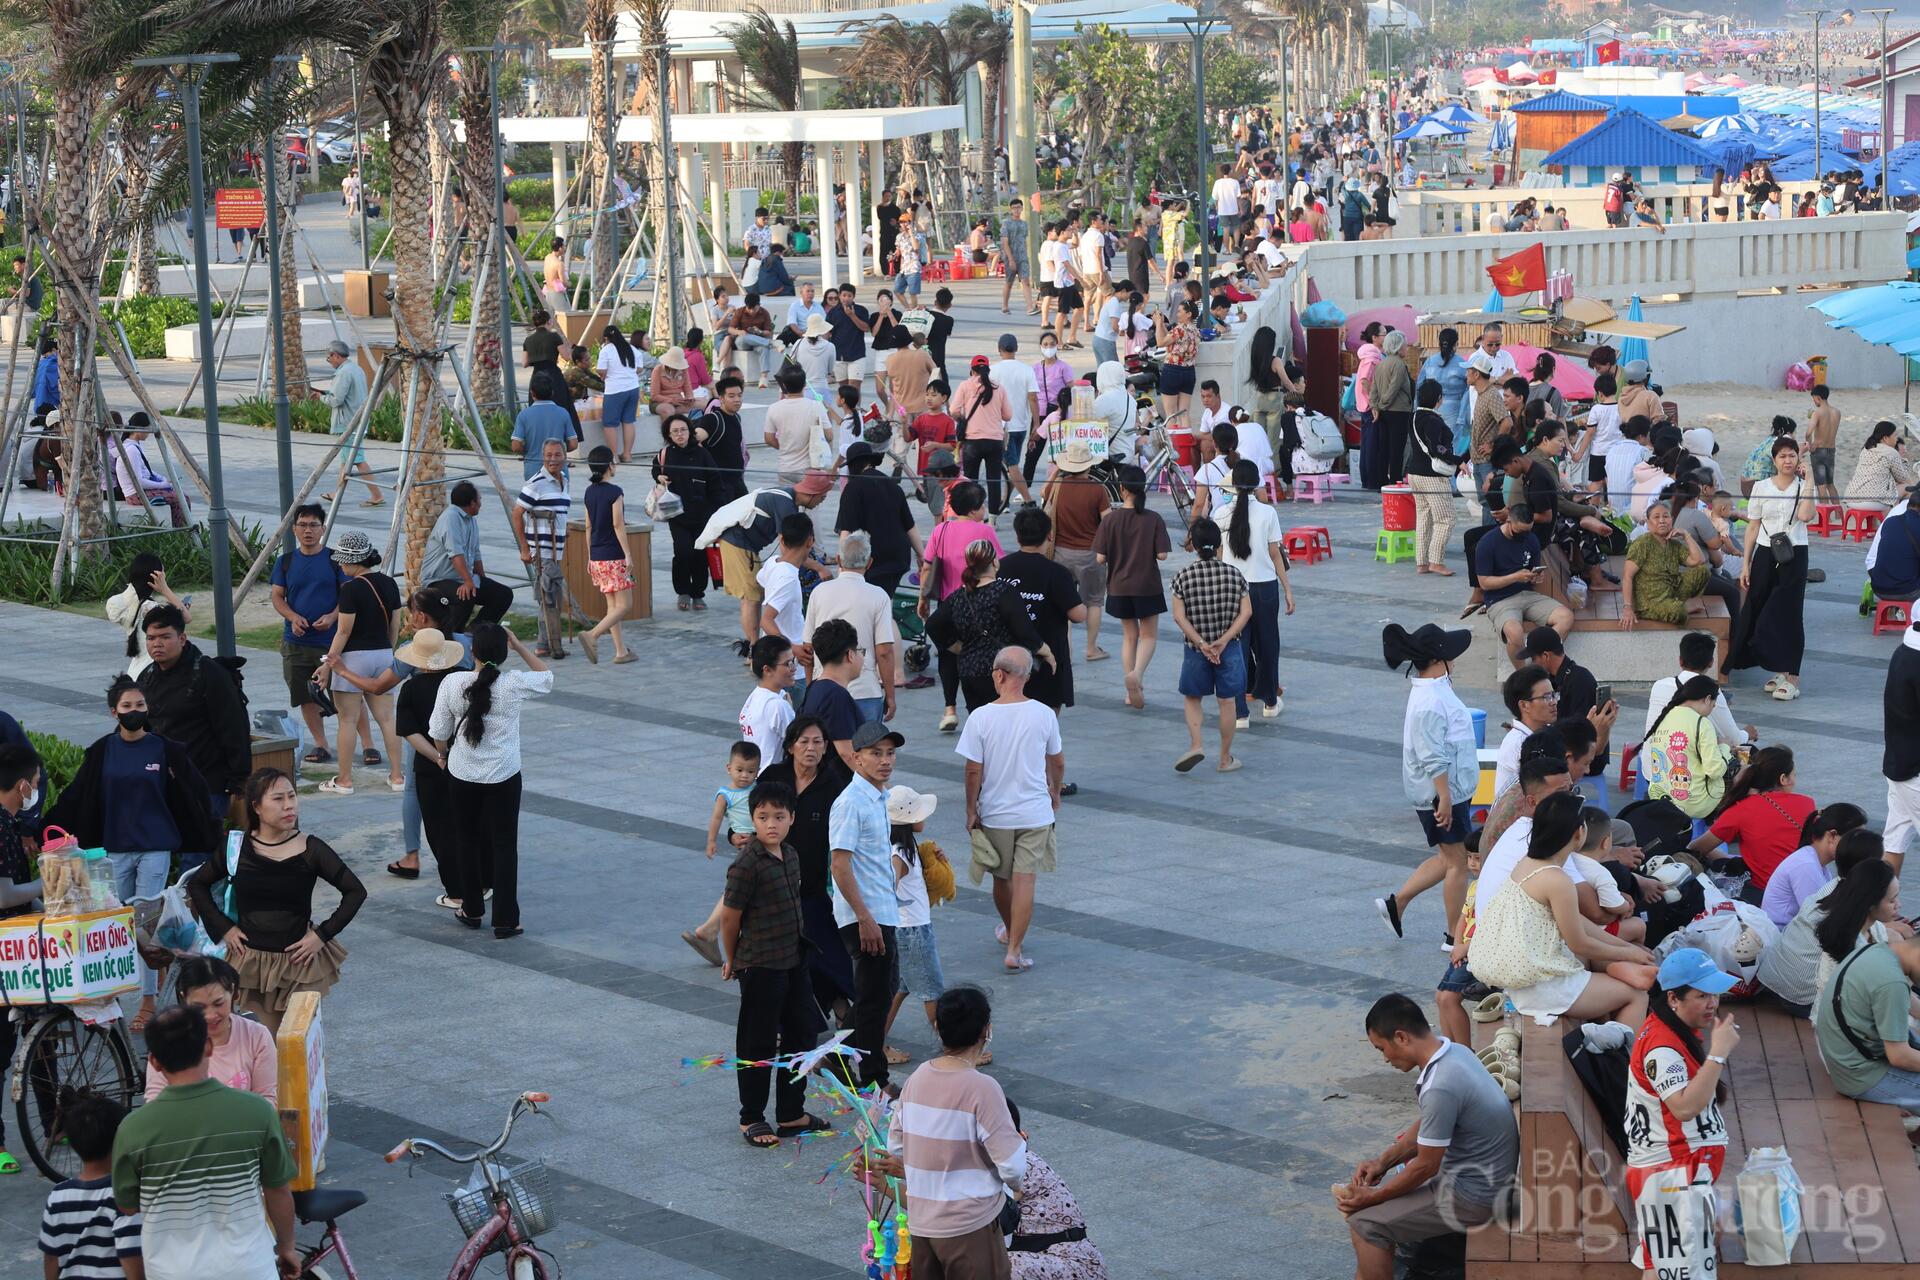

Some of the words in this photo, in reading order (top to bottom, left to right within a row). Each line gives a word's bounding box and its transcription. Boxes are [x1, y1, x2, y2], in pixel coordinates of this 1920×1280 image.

[1075, 428, 1088, 439] KEM
[28, 931, 59, 960] ỐNG
[86, 930, 107, 953] KEM
[108, 922, 128, 949] ỐNG
[22, 962, 41, 990] ỐC
[44, 960, 74, 993] QUẾ
[82, 961, 103, 985] KEM
[104, 951, 117, 980] ỐC
[117, 947, 135, 981] QUẾ
